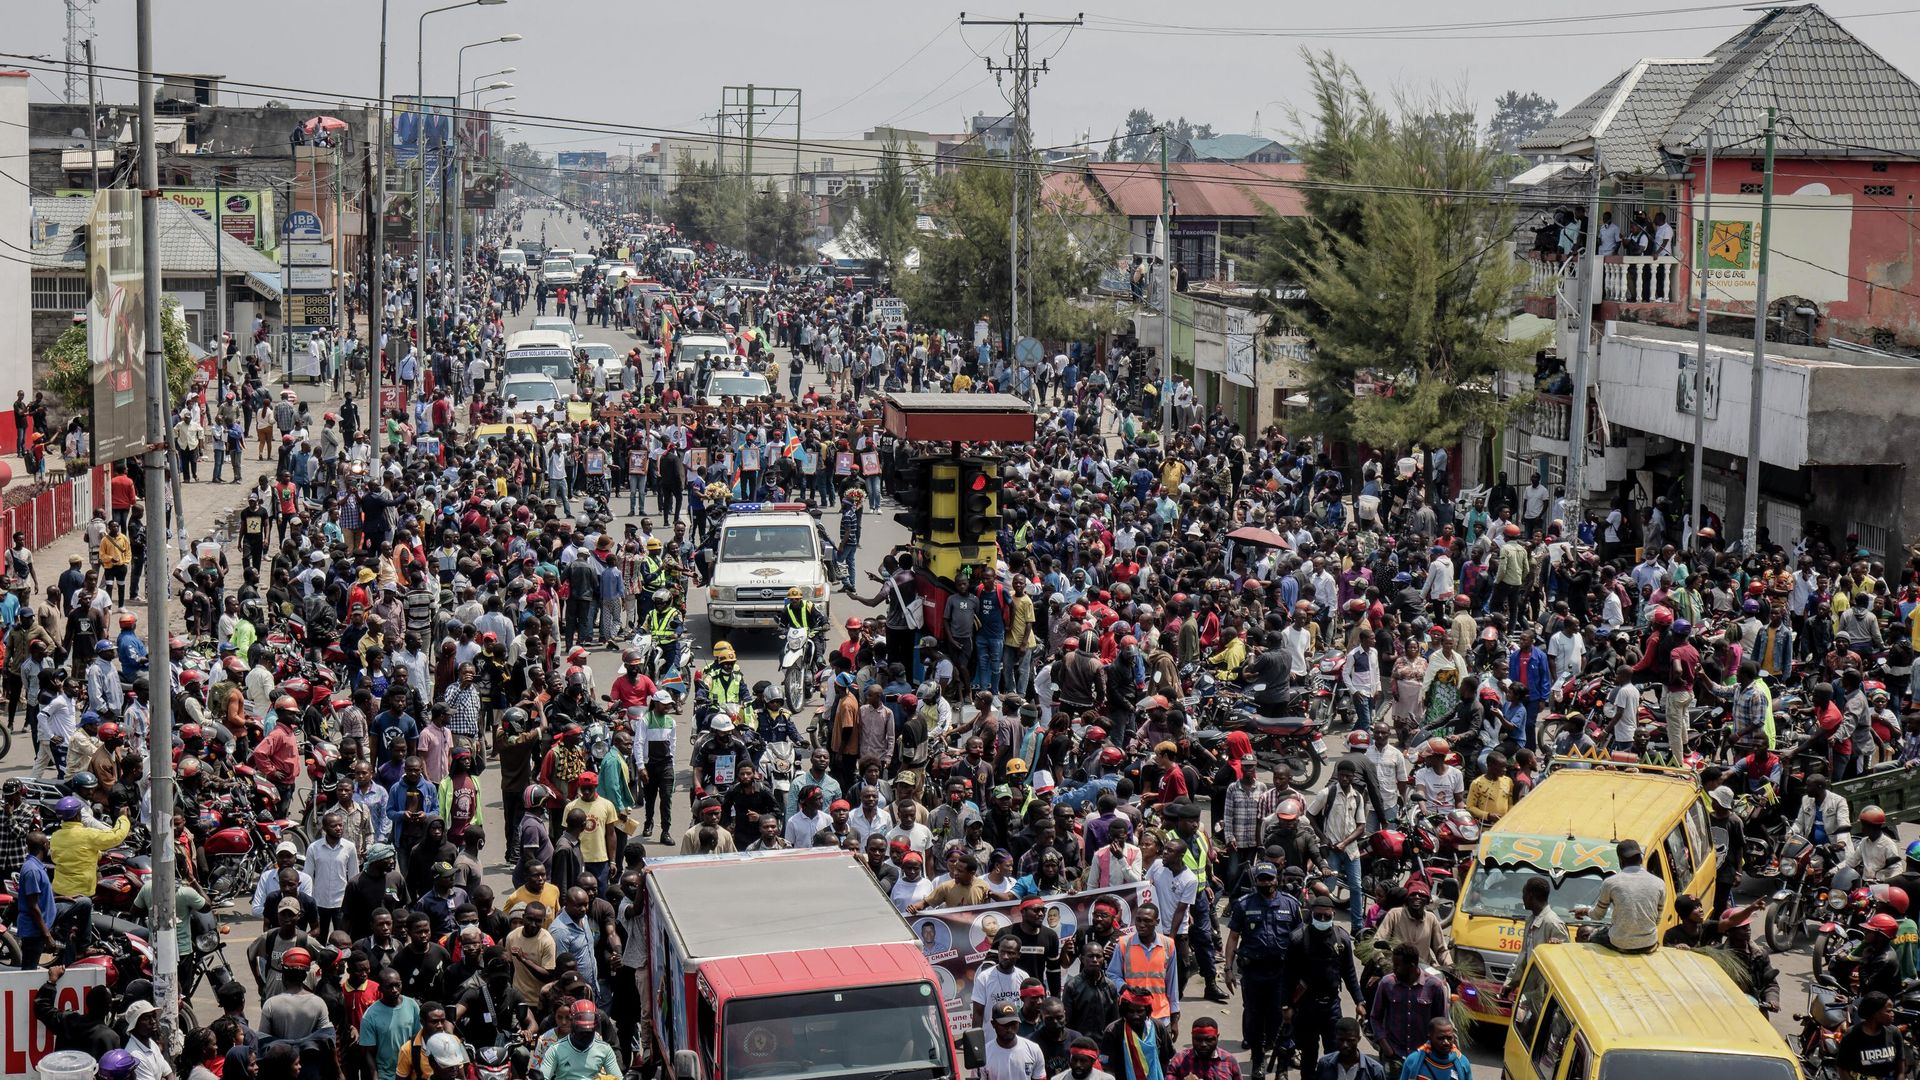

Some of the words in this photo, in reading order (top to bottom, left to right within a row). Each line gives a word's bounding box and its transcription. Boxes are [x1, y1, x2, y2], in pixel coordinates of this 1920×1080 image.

[172, 194, 204, 208] Shop
[293, 215, 314, 225] IBB
[1501, 838, 1612, 868] SIX
[1498, 938, 1522, 951] 316
[931, 950, 958, 962] CHANCE
[997, 991, 1020, 999] LUCHA
[952, 1013, 968, 1021] une
